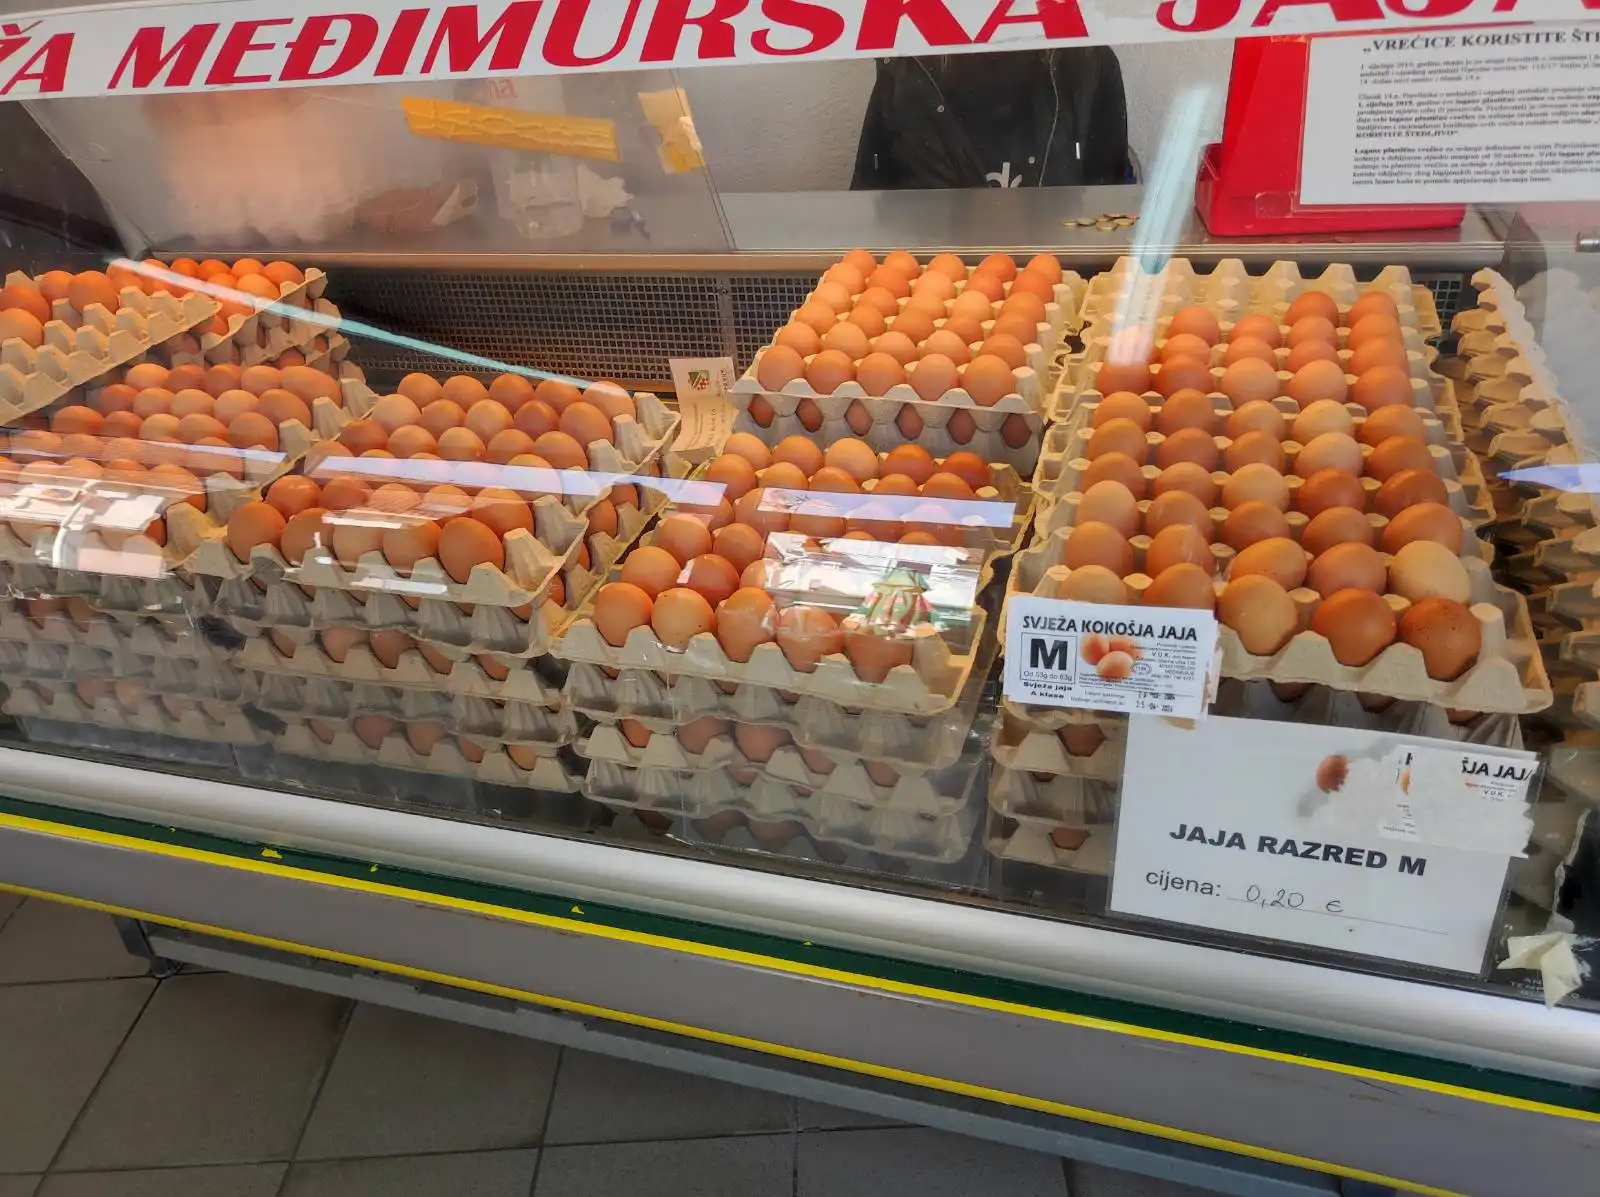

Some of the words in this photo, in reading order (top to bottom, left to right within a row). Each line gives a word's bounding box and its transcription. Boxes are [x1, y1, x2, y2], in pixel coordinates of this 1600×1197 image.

[1462, 31, 1566, 47] KORISTITE
[1022, 614, 1077, 633] SVJEŽA
[1081, 618, 1154, 639] KOKOŠJA
[1158, 625, 1198, 642] JAJA
[1029, 637, 1069, 671] M
[1035, 670, 1048, 680] 53g
[1059, 673, 1073, 682] 63g
[1169, 823, 1246, 850] JAJA
[1257, 835, 1388, 869] RAZRED
[1398, 855, 1427, 876] M
[1145, 870, 1221, 897] cijena:
[1246, 885, 1305, 909] 0,20
[1326, 900, 1344, 913] €
